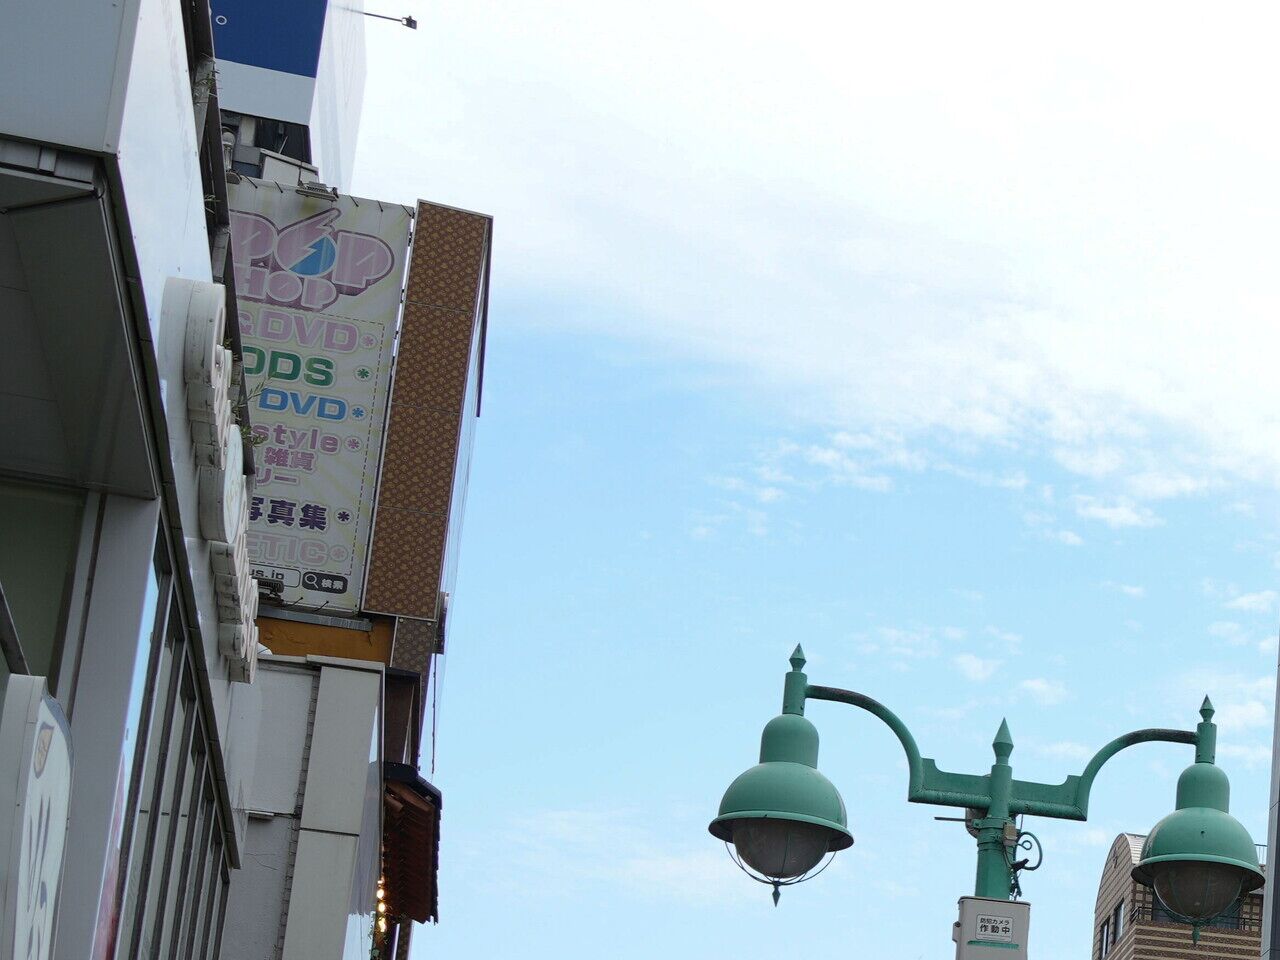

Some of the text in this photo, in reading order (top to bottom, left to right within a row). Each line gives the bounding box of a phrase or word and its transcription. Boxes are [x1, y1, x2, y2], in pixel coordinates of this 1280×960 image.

[230, 208, 395, 297] POP
[258, 309, 359, 351] DVD
[258, 387, 347, 421] DVD
[252, 424, 340, 453] style
[979, 925, 1011, 934] 作動中
